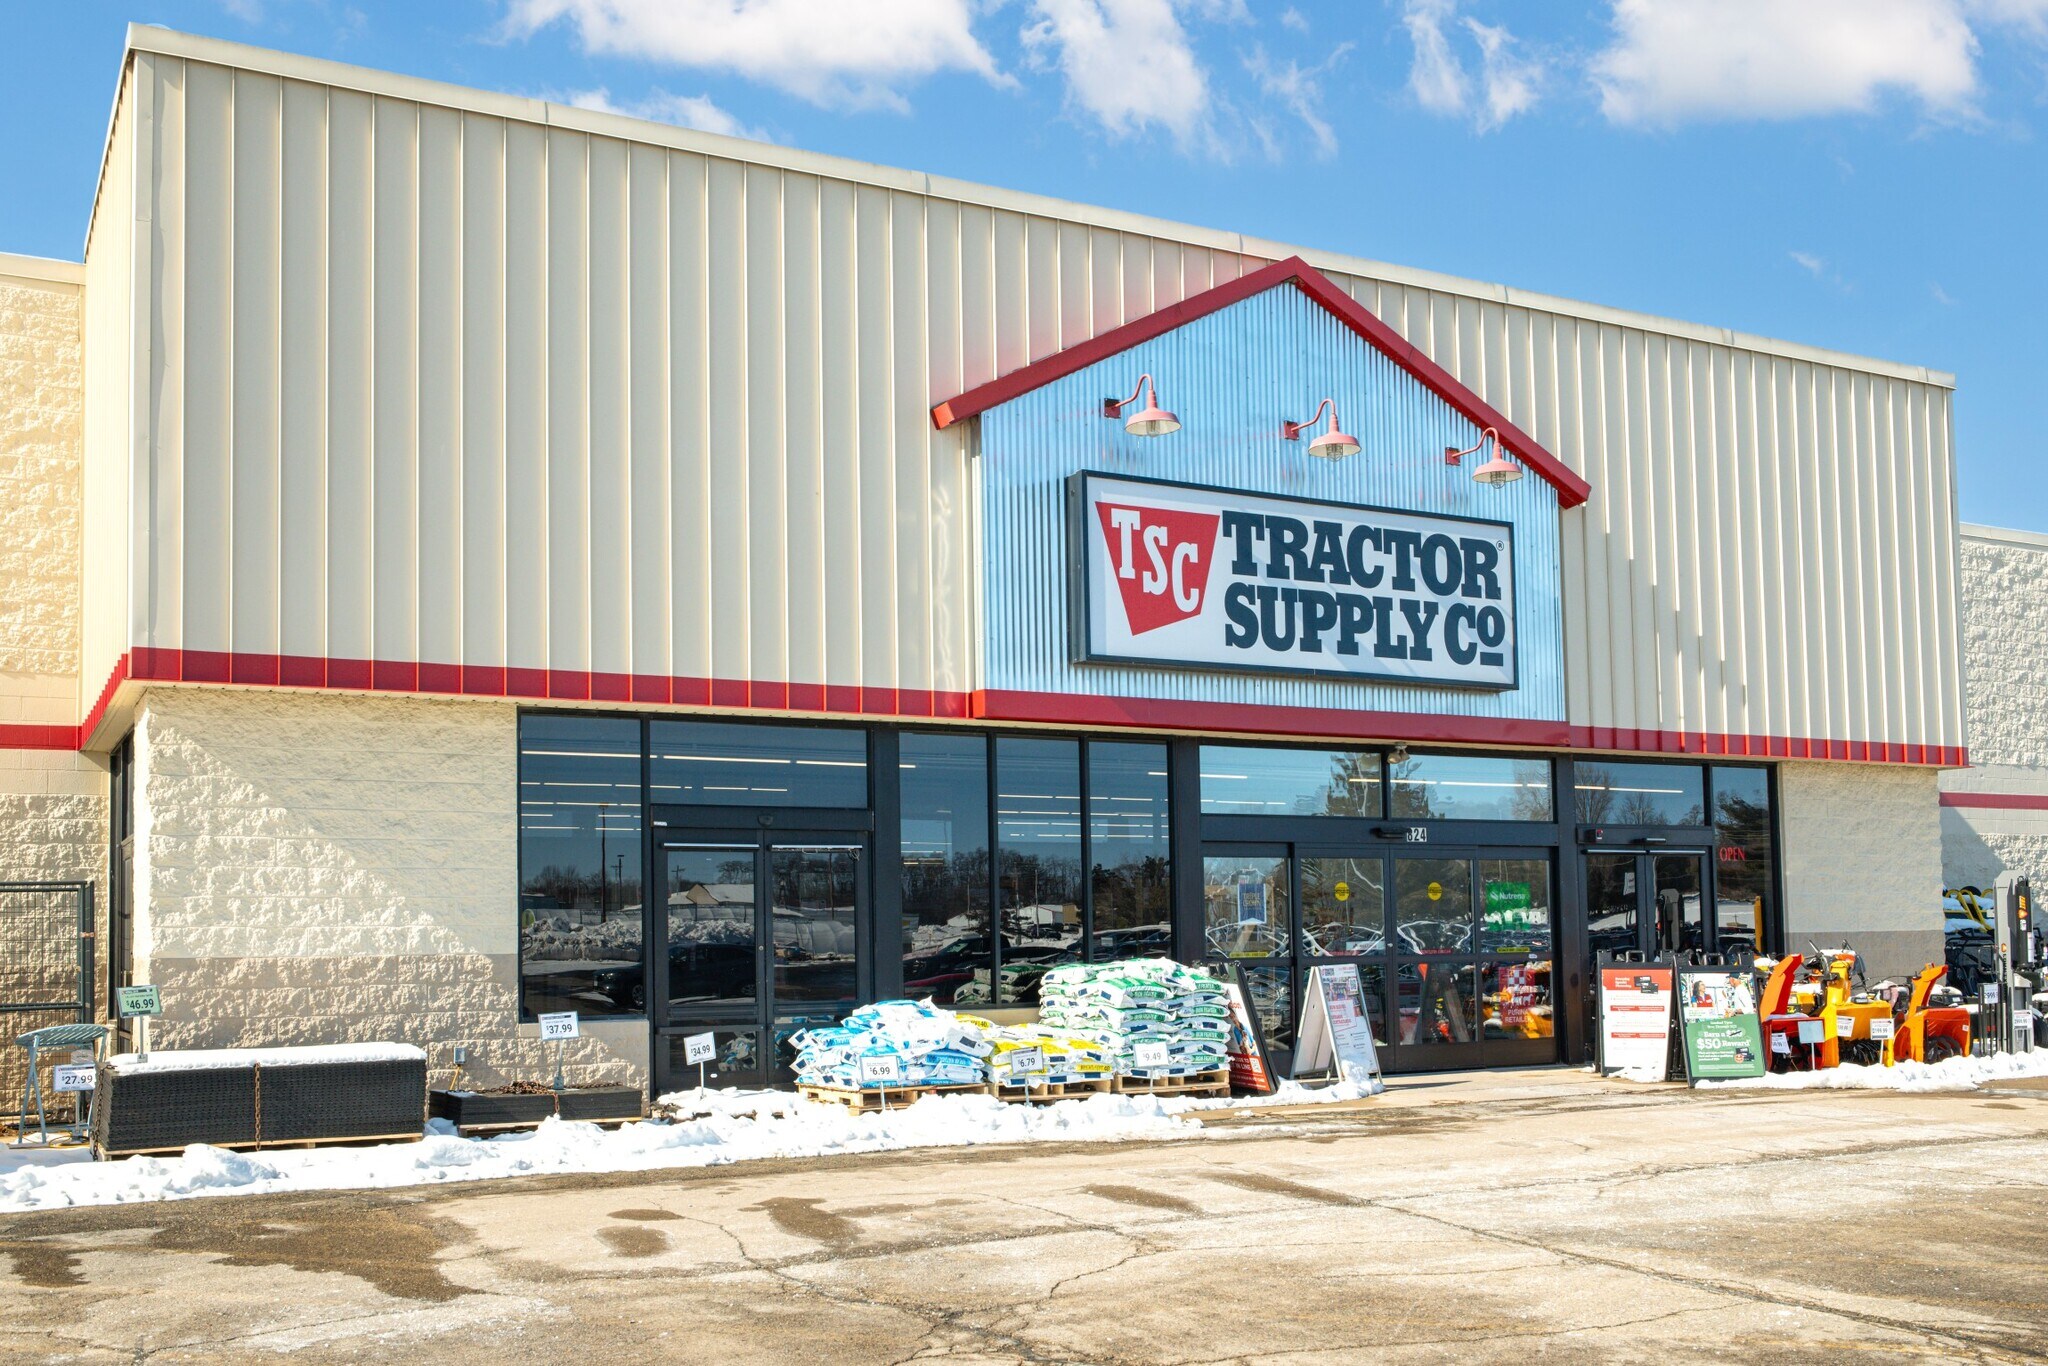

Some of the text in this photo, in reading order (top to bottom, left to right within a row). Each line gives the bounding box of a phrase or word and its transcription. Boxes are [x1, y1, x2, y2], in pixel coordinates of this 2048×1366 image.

[1111, 508, 1200, 613] TSC
[1222, 510, 1502, 600] TRACTOR
[1224, 582, 1439, 661] SUPPLY
[1719, 846, 1746, 862] OPEN
[1500, 892, 1526, 900] Nutrena
[126, 998, 154, 1009] $46.99
[546, 1023, 572, 1034] $37.99
[691, 1044, 711, 1056] $34.99
[1696, 1038, 1721, 1050] $50
[62, 1075, 92, 1085] $27.99
